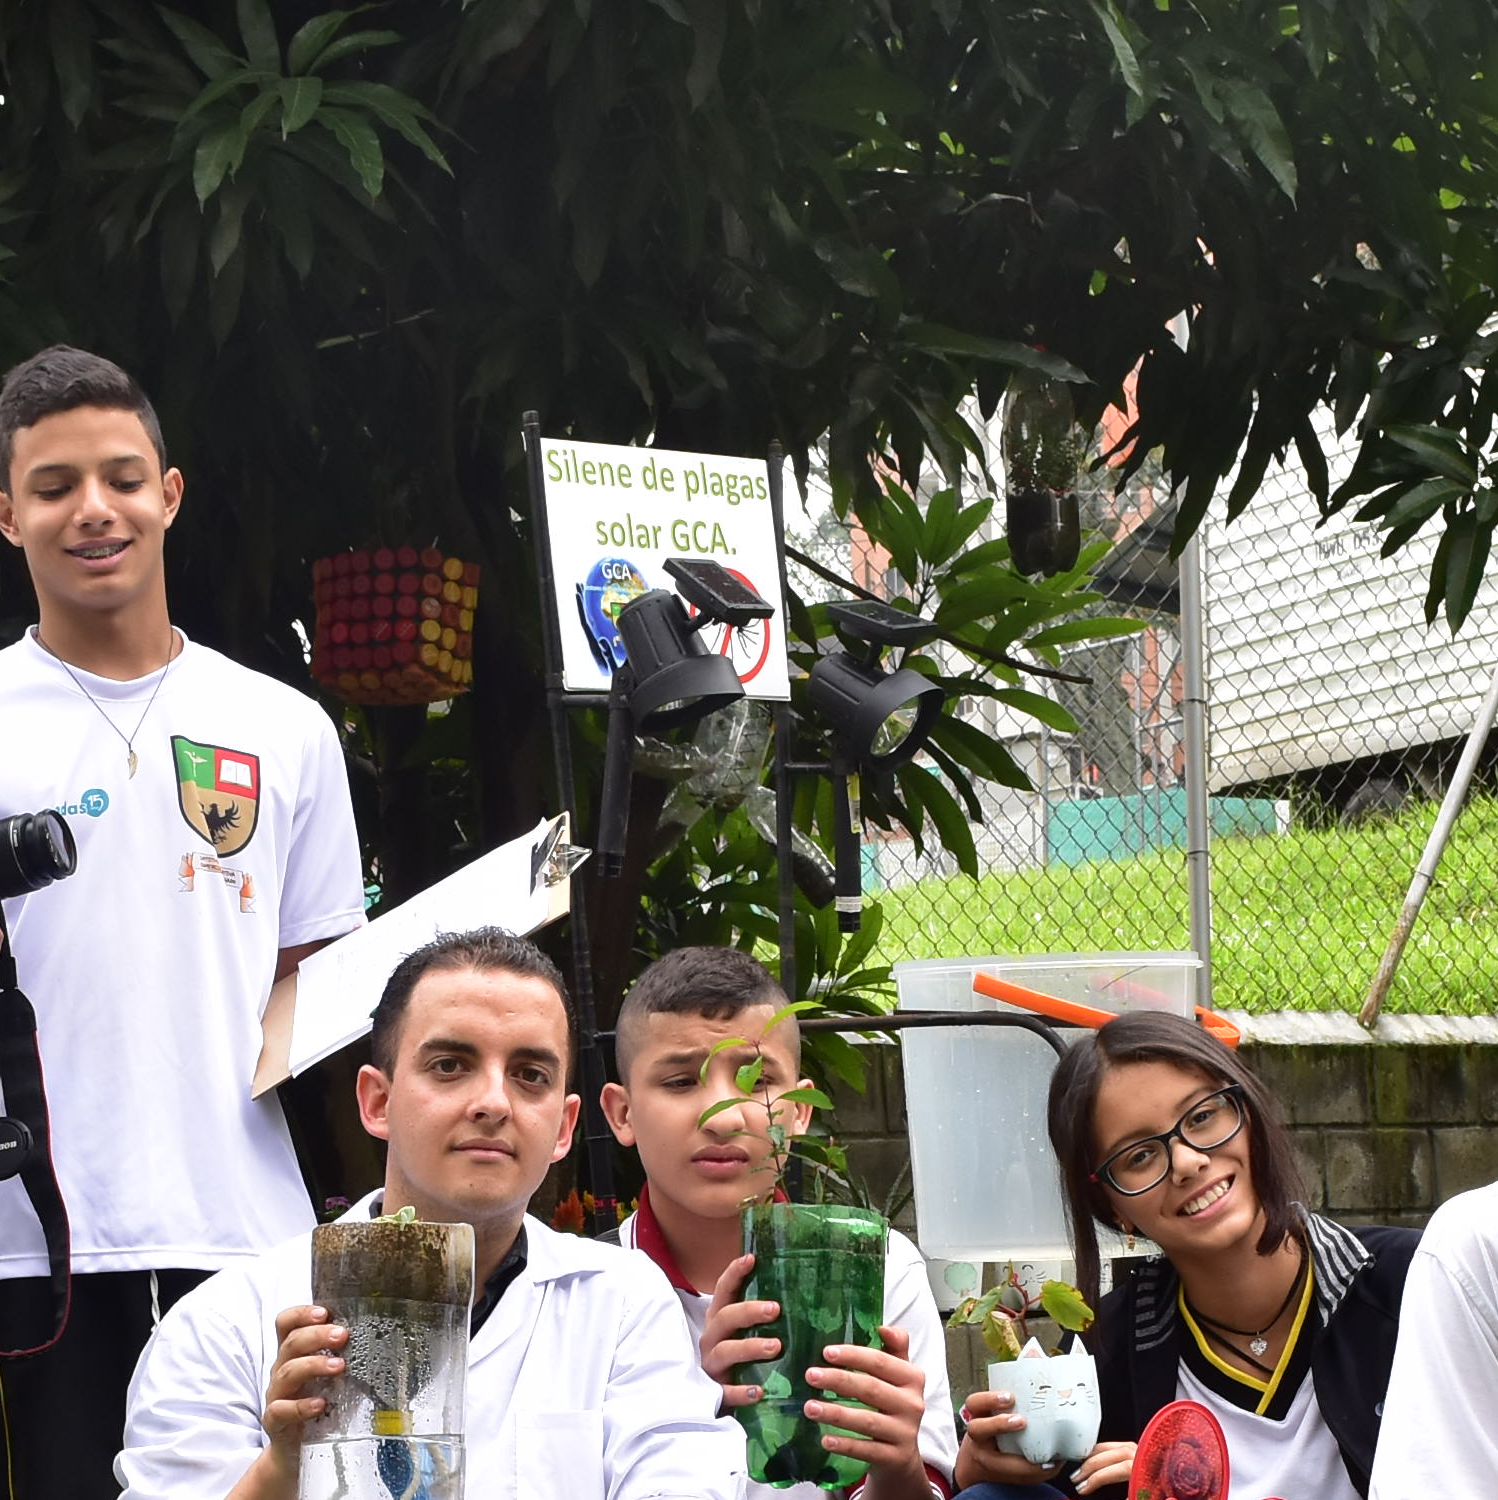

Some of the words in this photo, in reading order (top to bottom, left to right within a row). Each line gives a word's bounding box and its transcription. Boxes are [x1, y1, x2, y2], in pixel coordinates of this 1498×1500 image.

[547, 449, 632, 488] Silene
[642, 457, 674, 492] de
[684, 462, 767, 505] plagas
[596, 513, 661, 549] solar
[670, 519, 736, 555] GCA.
[601, 563, 631, 580] GCA
[87, 794, 104, 811] 15
